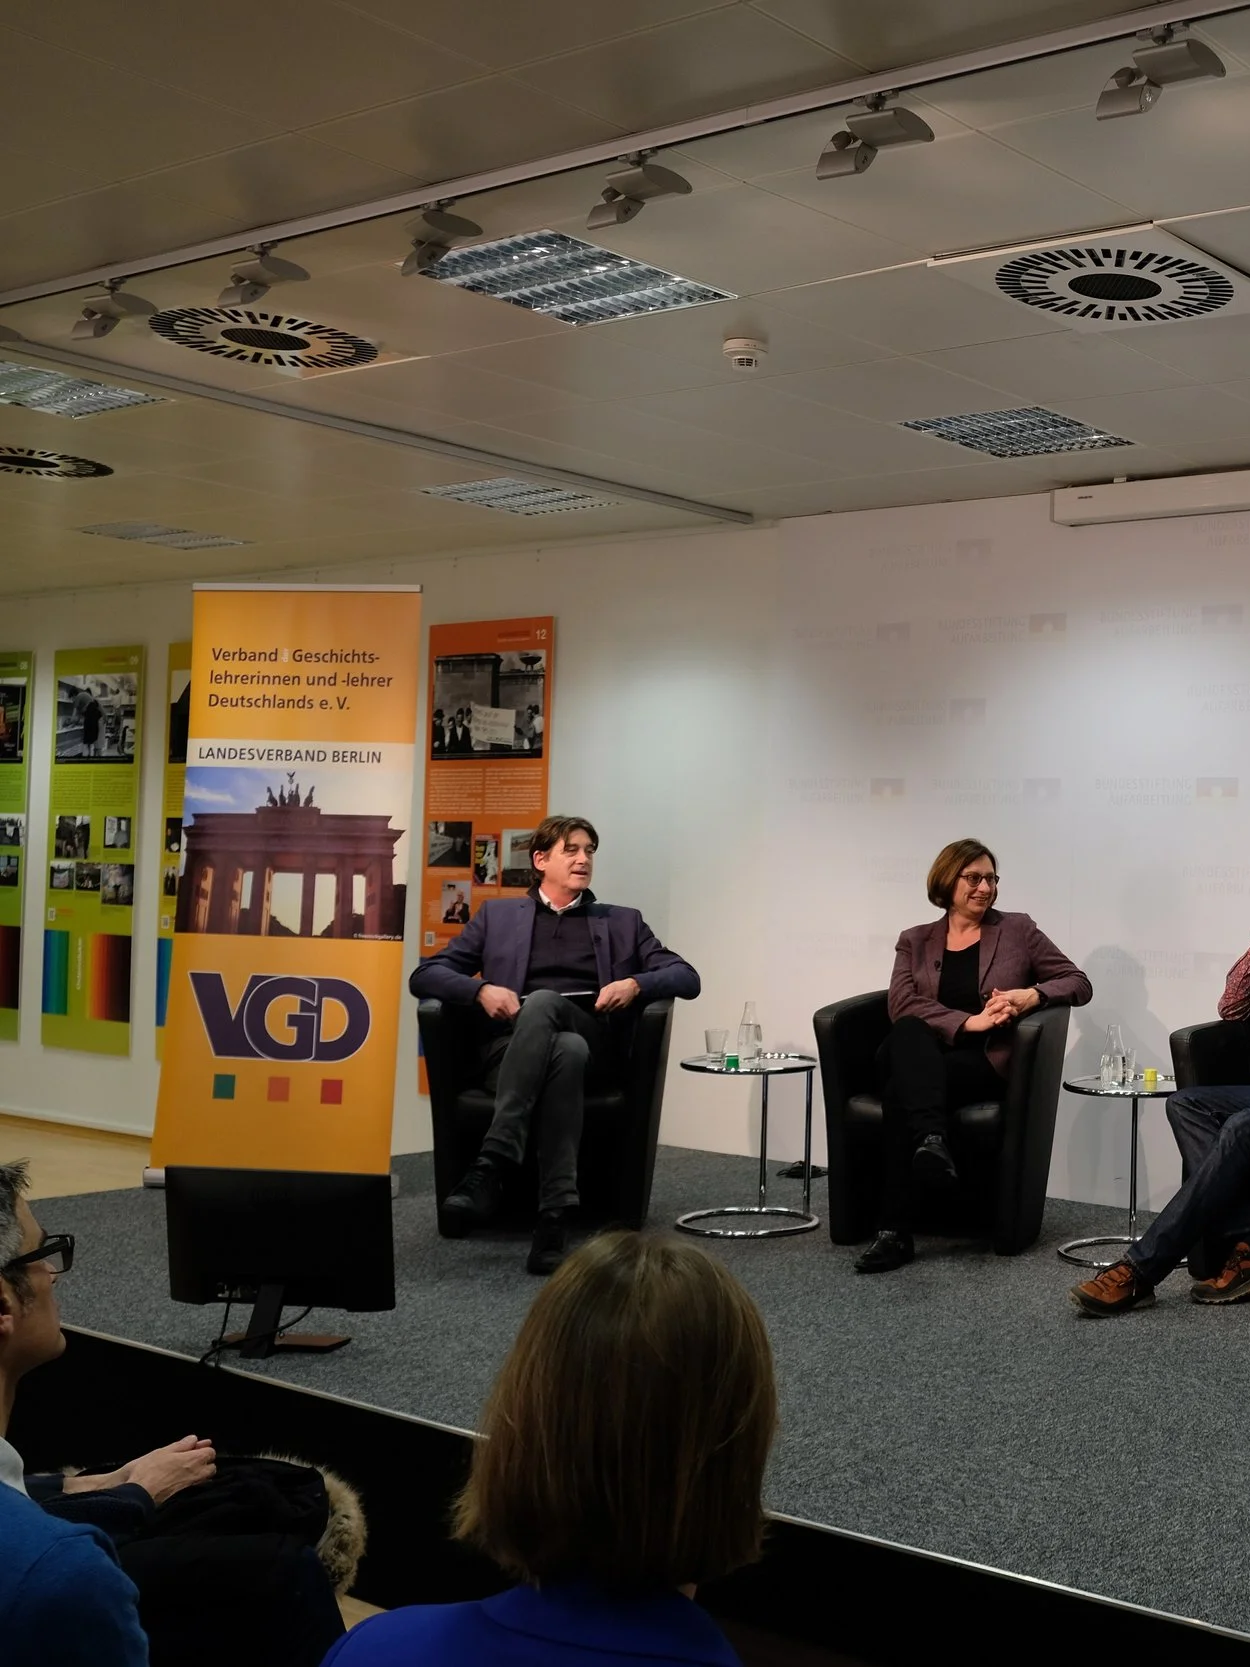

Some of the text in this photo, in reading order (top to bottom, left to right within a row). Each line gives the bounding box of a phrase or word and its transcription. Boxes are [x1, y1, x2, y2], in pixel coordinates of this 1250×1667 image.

[535, 627, 547, 640] 12
[212, 647, 278, 663] Verband
[292, 648, 380, 664] Geschichts-
[209, 670, 394, 688] lehrerinnen und -lehrer
[208, 693, 351, 711] Deutschlands e. V.
[198, 747, 382, 764] LANDESVERBAND BERLIN
[188, 971, 371, 1063] VGD
